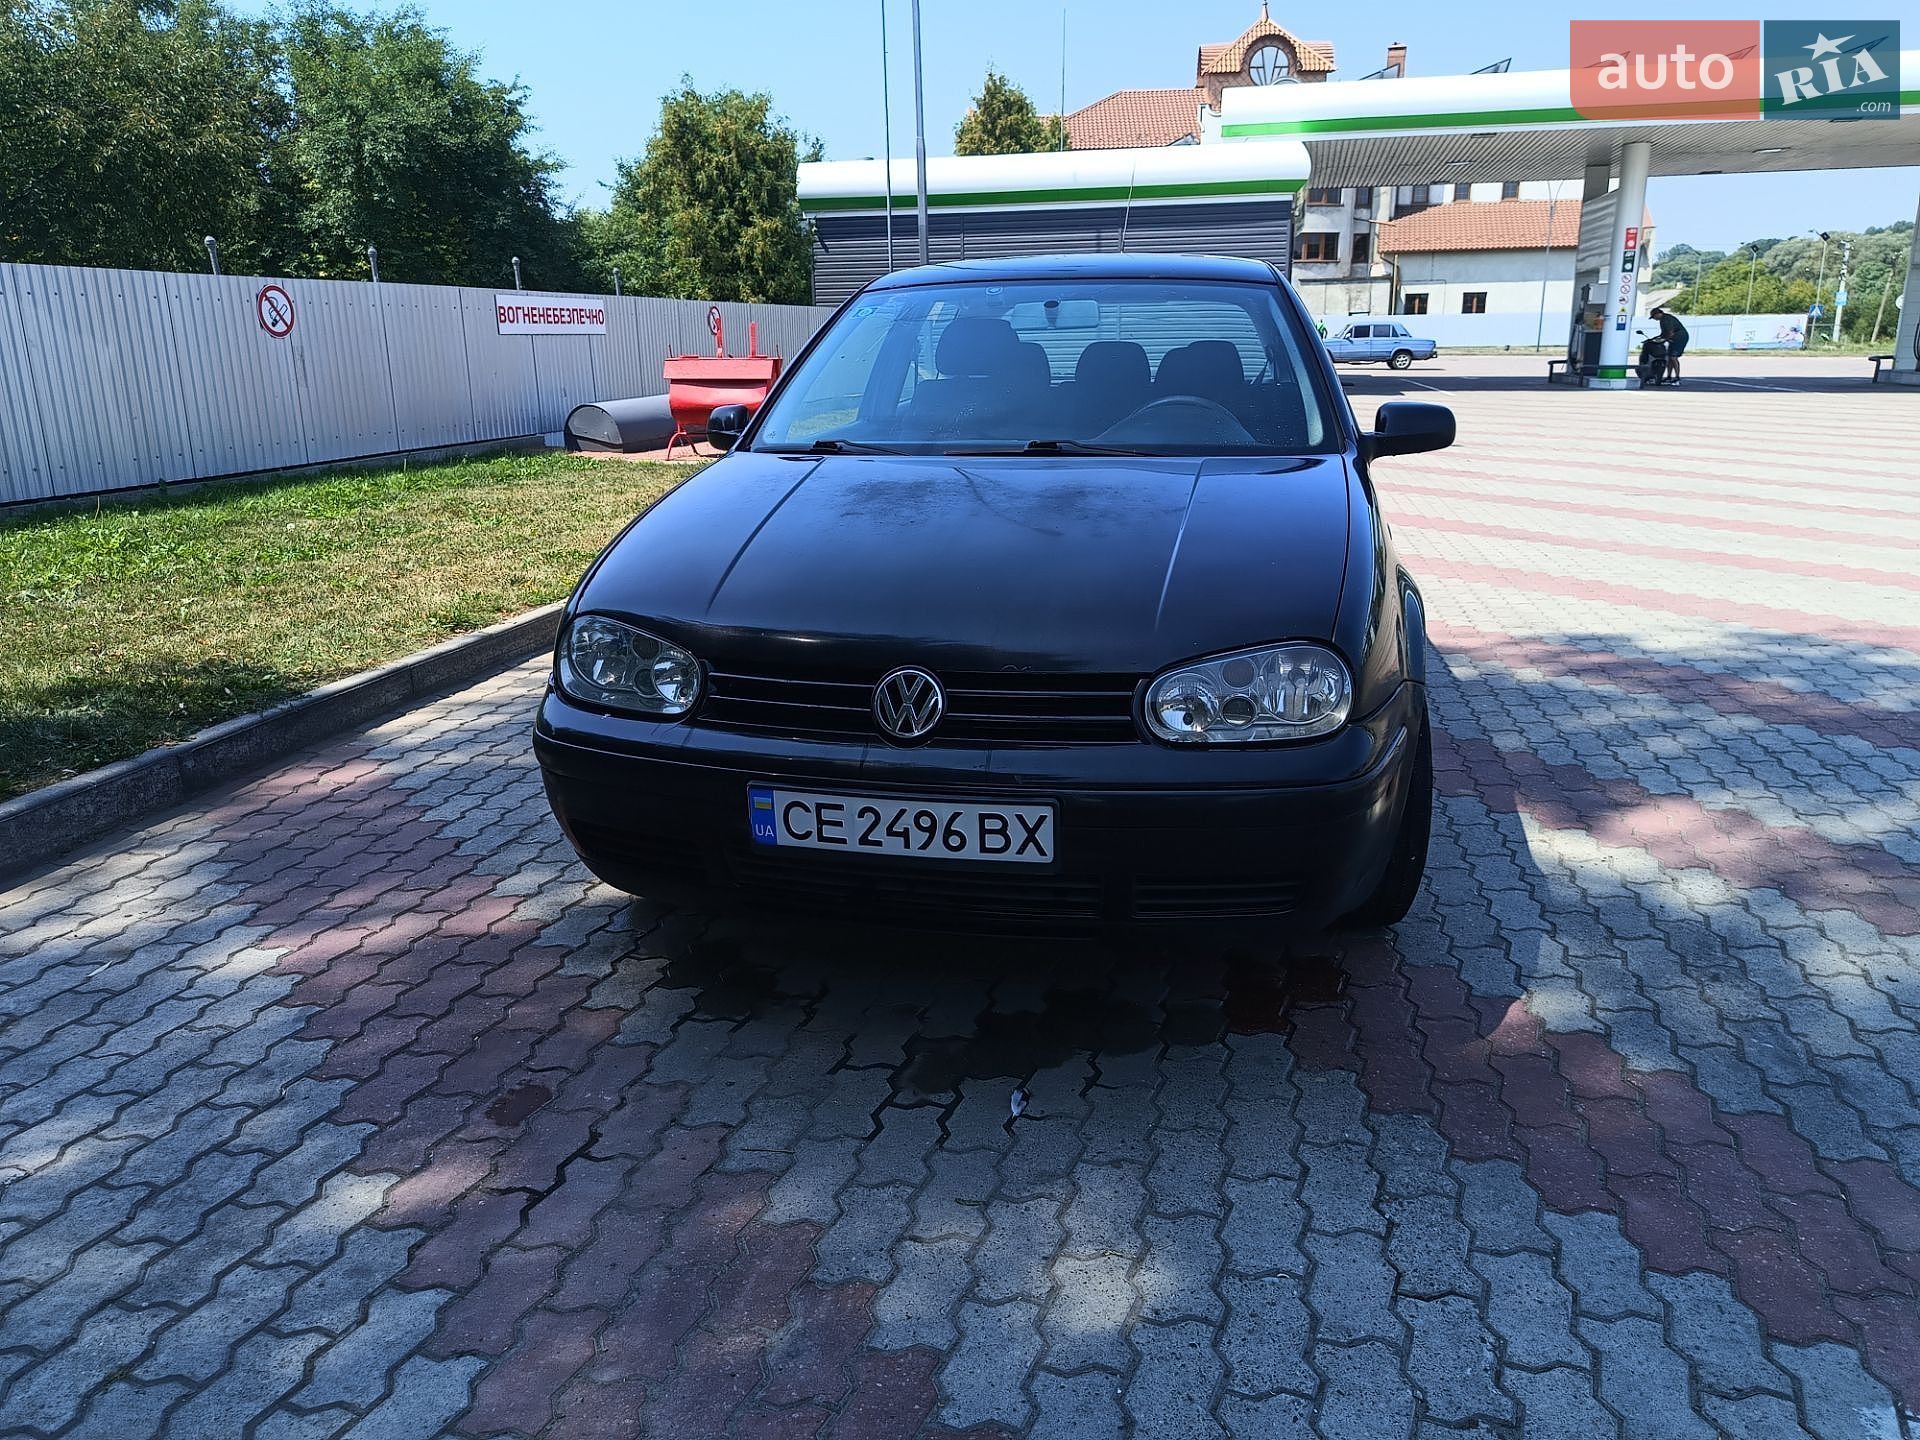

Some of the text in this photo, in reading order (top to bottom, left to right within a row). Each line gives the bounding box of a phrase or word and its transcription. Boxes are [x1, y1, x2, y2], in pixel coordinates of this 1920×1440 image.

[498, 305, 605, 325] ВОГНЕНЕБЕЗПЕЧНО
[755, 822, 775, 838] UA
[782, 800, 1049, 857] CE 2496 BX
